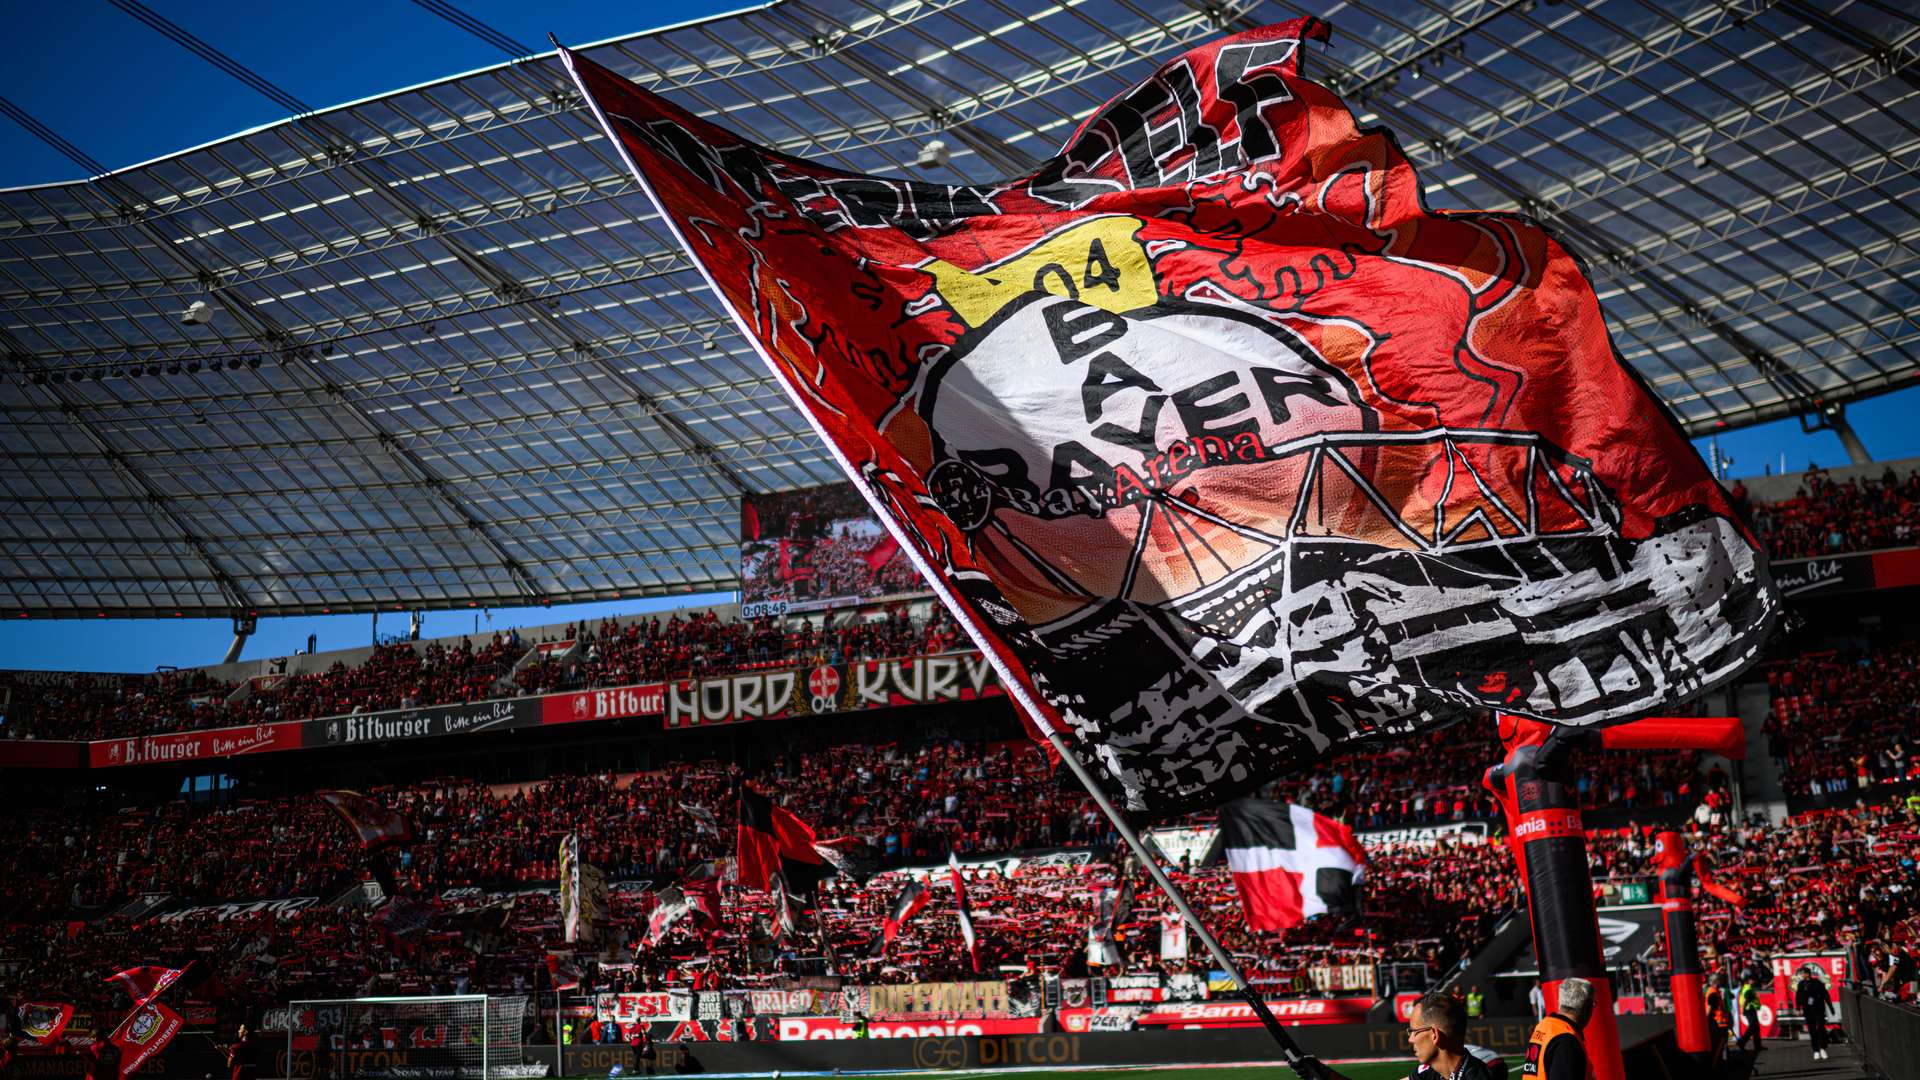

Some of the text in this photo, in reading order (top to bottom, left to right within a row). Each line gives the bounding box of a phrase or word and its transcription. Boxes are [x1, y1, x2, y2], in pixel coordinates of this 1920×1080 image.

[1776, 561, 1842, 588] ein Bit
[670, 655, 990, 726] NORD 04 KURV
[345, 702, 515, 743] Bitburger Bitte ein Bit
[213, 739, 236, 754] Bitte
[256, 727, 275, 741] Bit
[1514, 816, 1547, 838] enia
[617, 995, 671, 1018] FSI
[1369, 1031, 1390, 1050] IT
